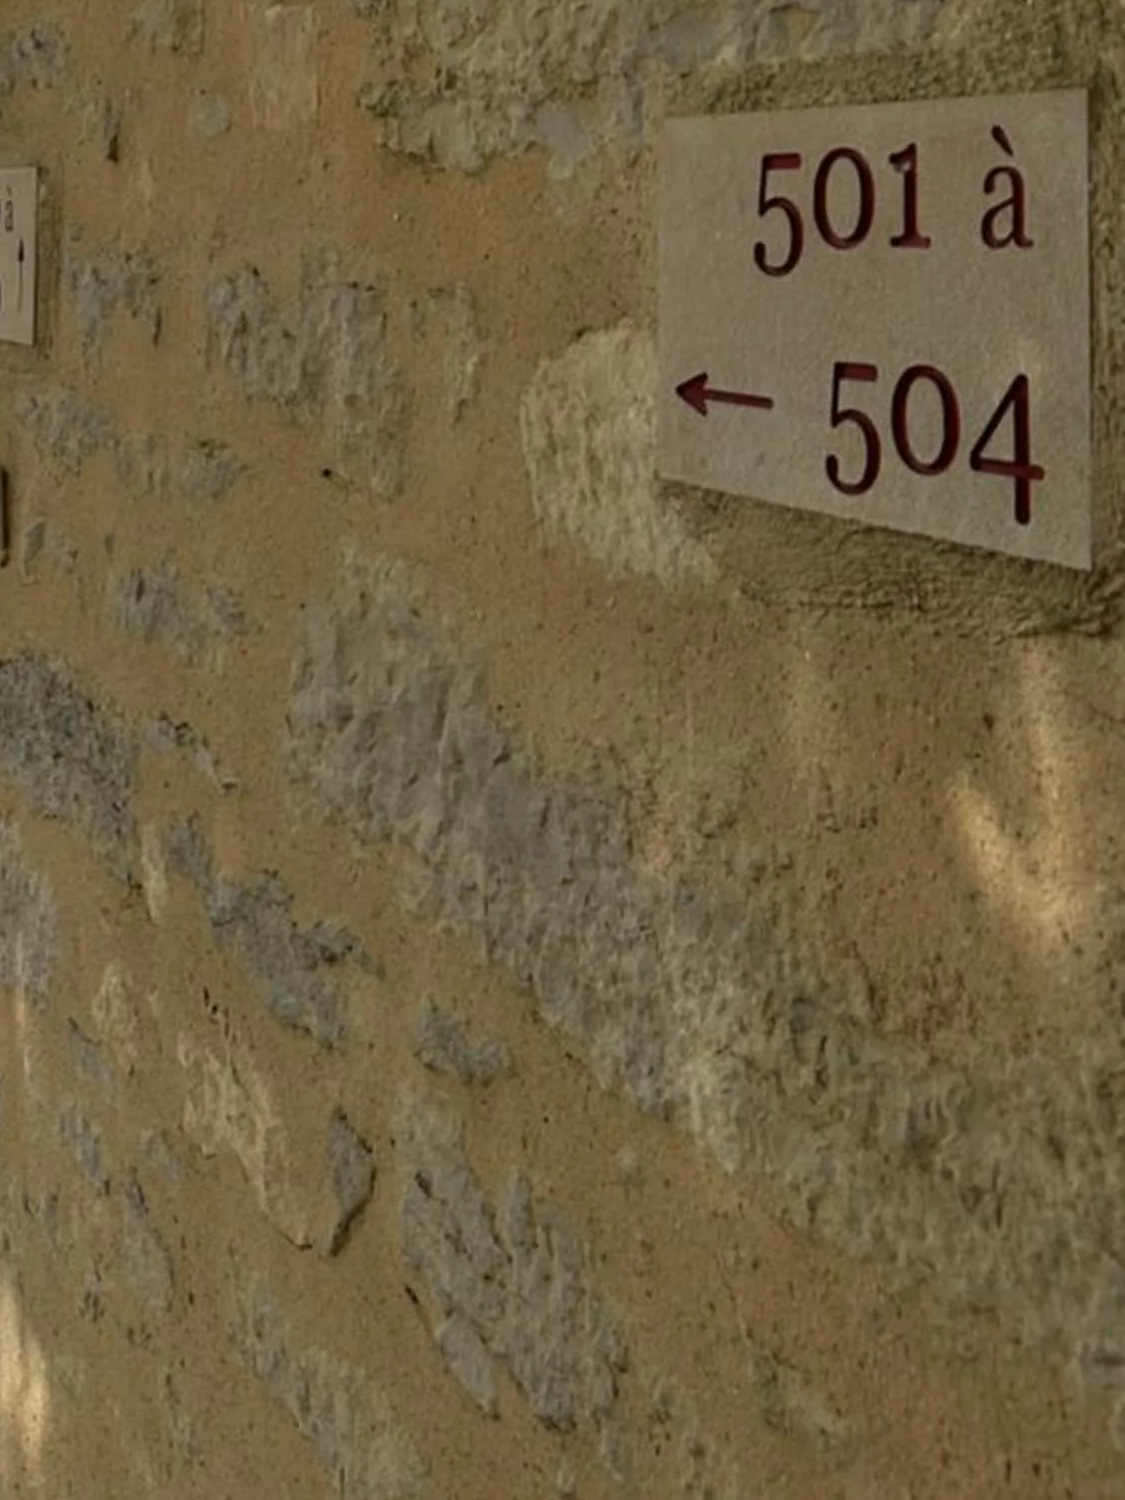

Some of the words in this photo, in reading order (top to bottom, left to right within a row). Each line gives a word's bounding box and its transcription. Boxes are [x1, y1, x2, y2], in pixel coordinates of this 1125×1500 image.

[4, 185, 14, 232] à
[753, 142, 931, 278] 501
[980, 124, 1034, 250] à
[825, 361, 1045, 526] 504
